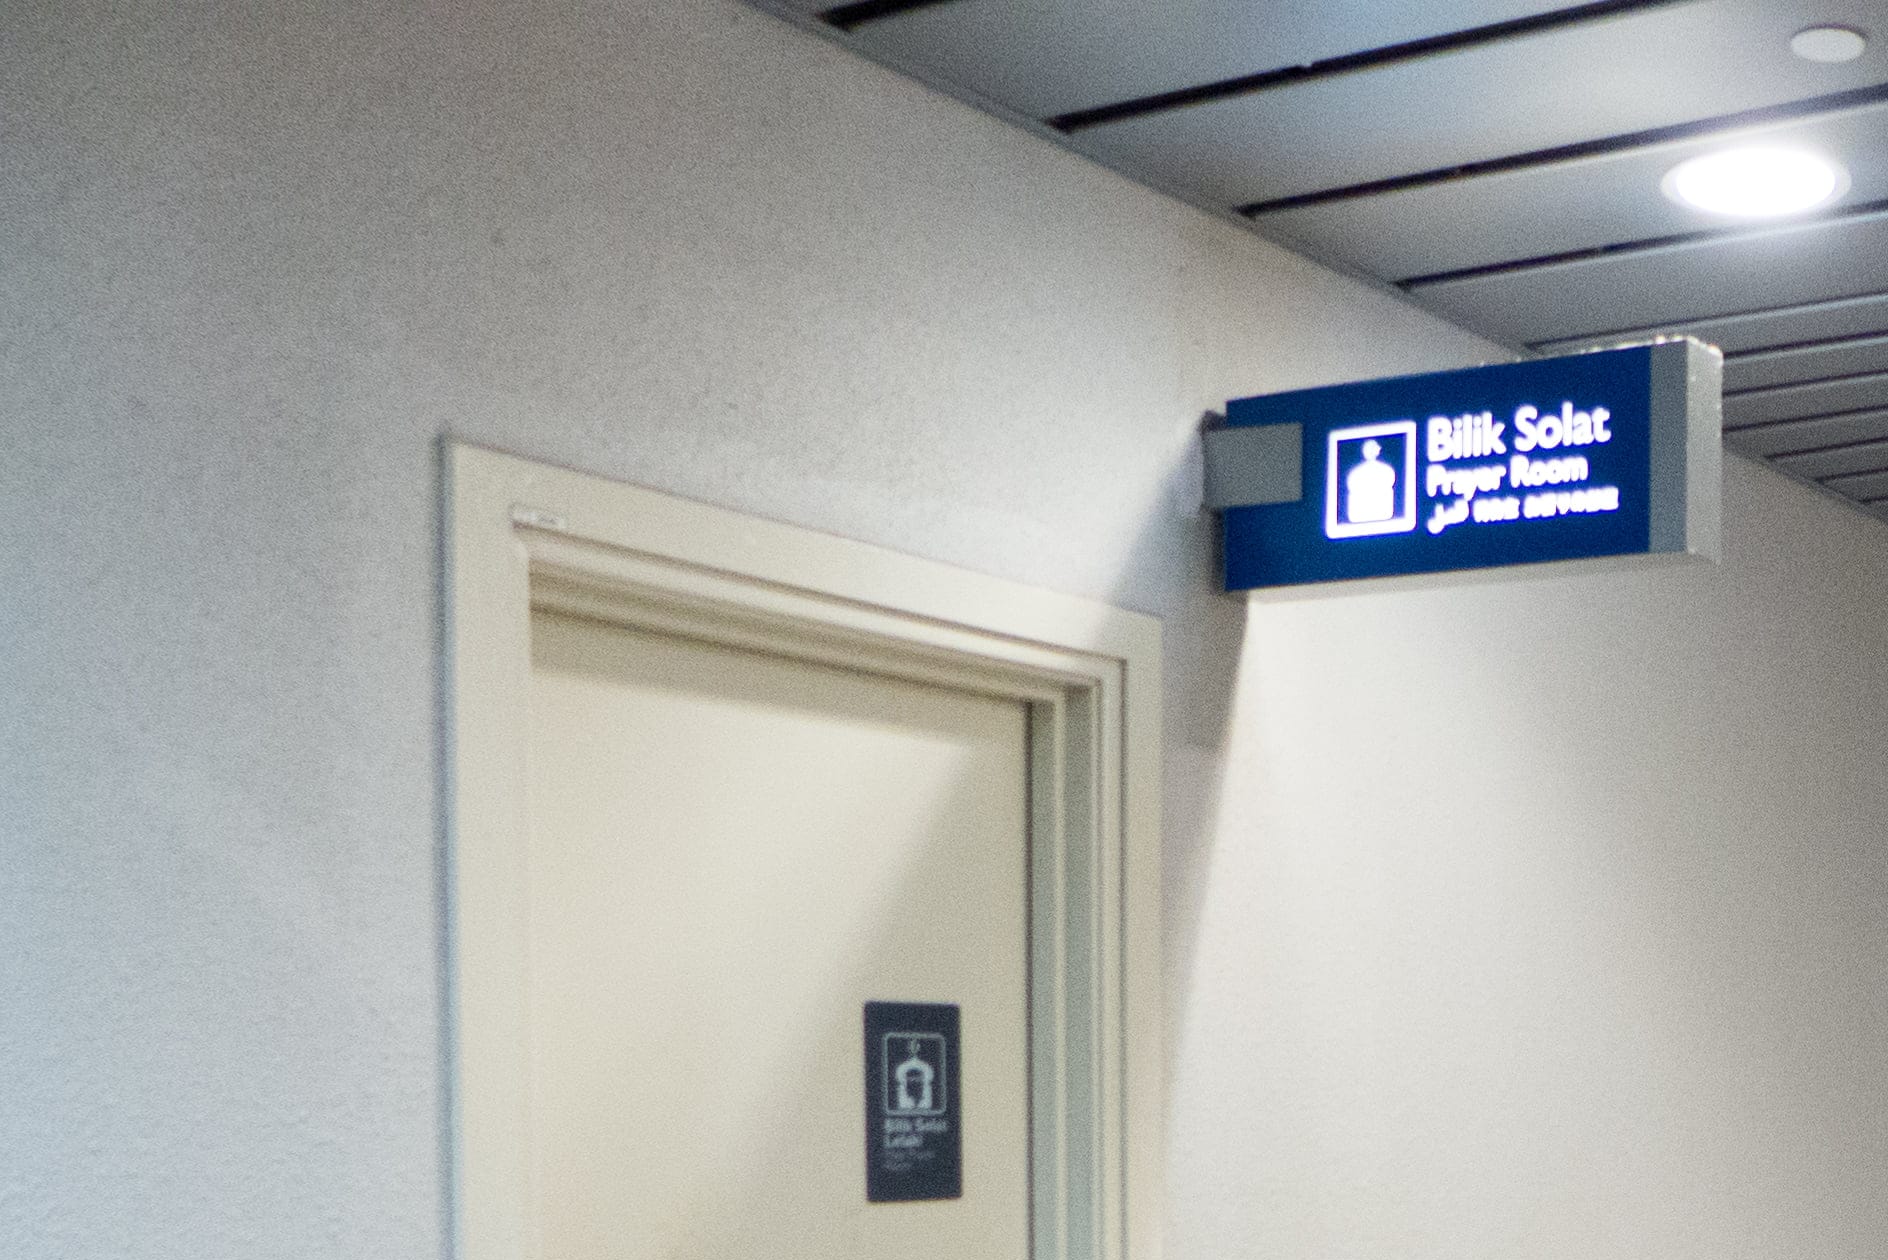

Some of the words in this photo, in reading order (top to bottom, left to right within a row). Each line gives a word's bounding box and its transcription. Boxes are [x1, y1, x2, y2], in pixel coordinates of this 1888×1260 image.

[1427, 411, 1507, 462] Bilik
[1514, 401, 1612, 452] Solat
[1427, 464, 1507, 502] Prayer
[1510, 454, 1589, 488] Room
